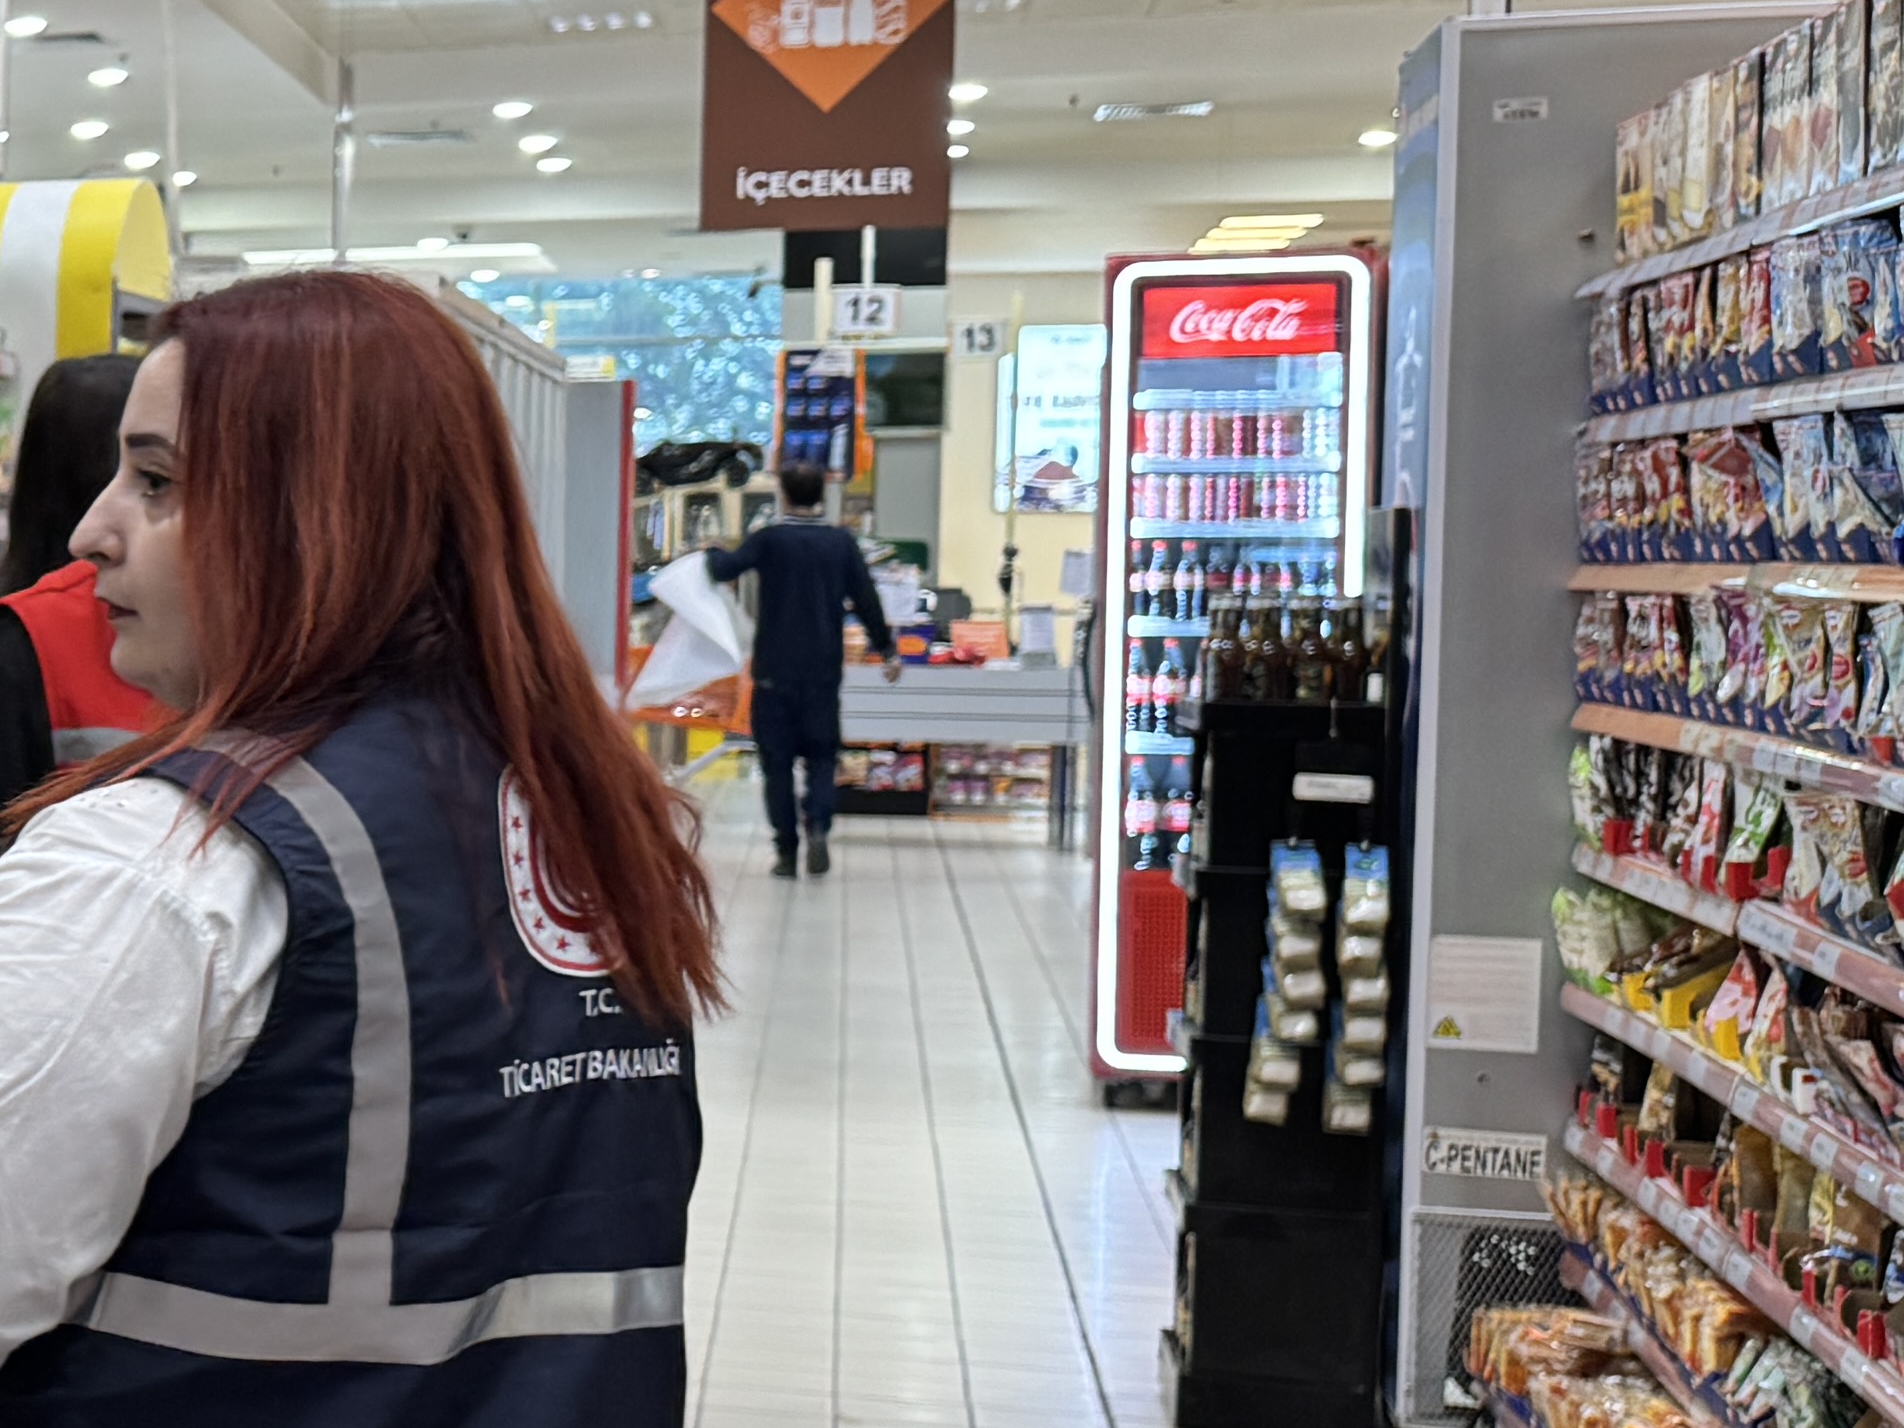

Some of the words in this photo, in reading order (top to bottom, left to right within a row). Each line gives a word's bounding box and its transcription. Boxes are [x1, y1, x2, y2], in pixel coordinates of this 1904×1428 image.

[736, 166, 912, 205] İÇECEKLER
[845, 294, 883, 325] 12
[960, 325, 997, 351] 13
[500, 1056, 586, 1098] TİCARET
[1424, 1140, 1542, 1175] C-PENTANE
